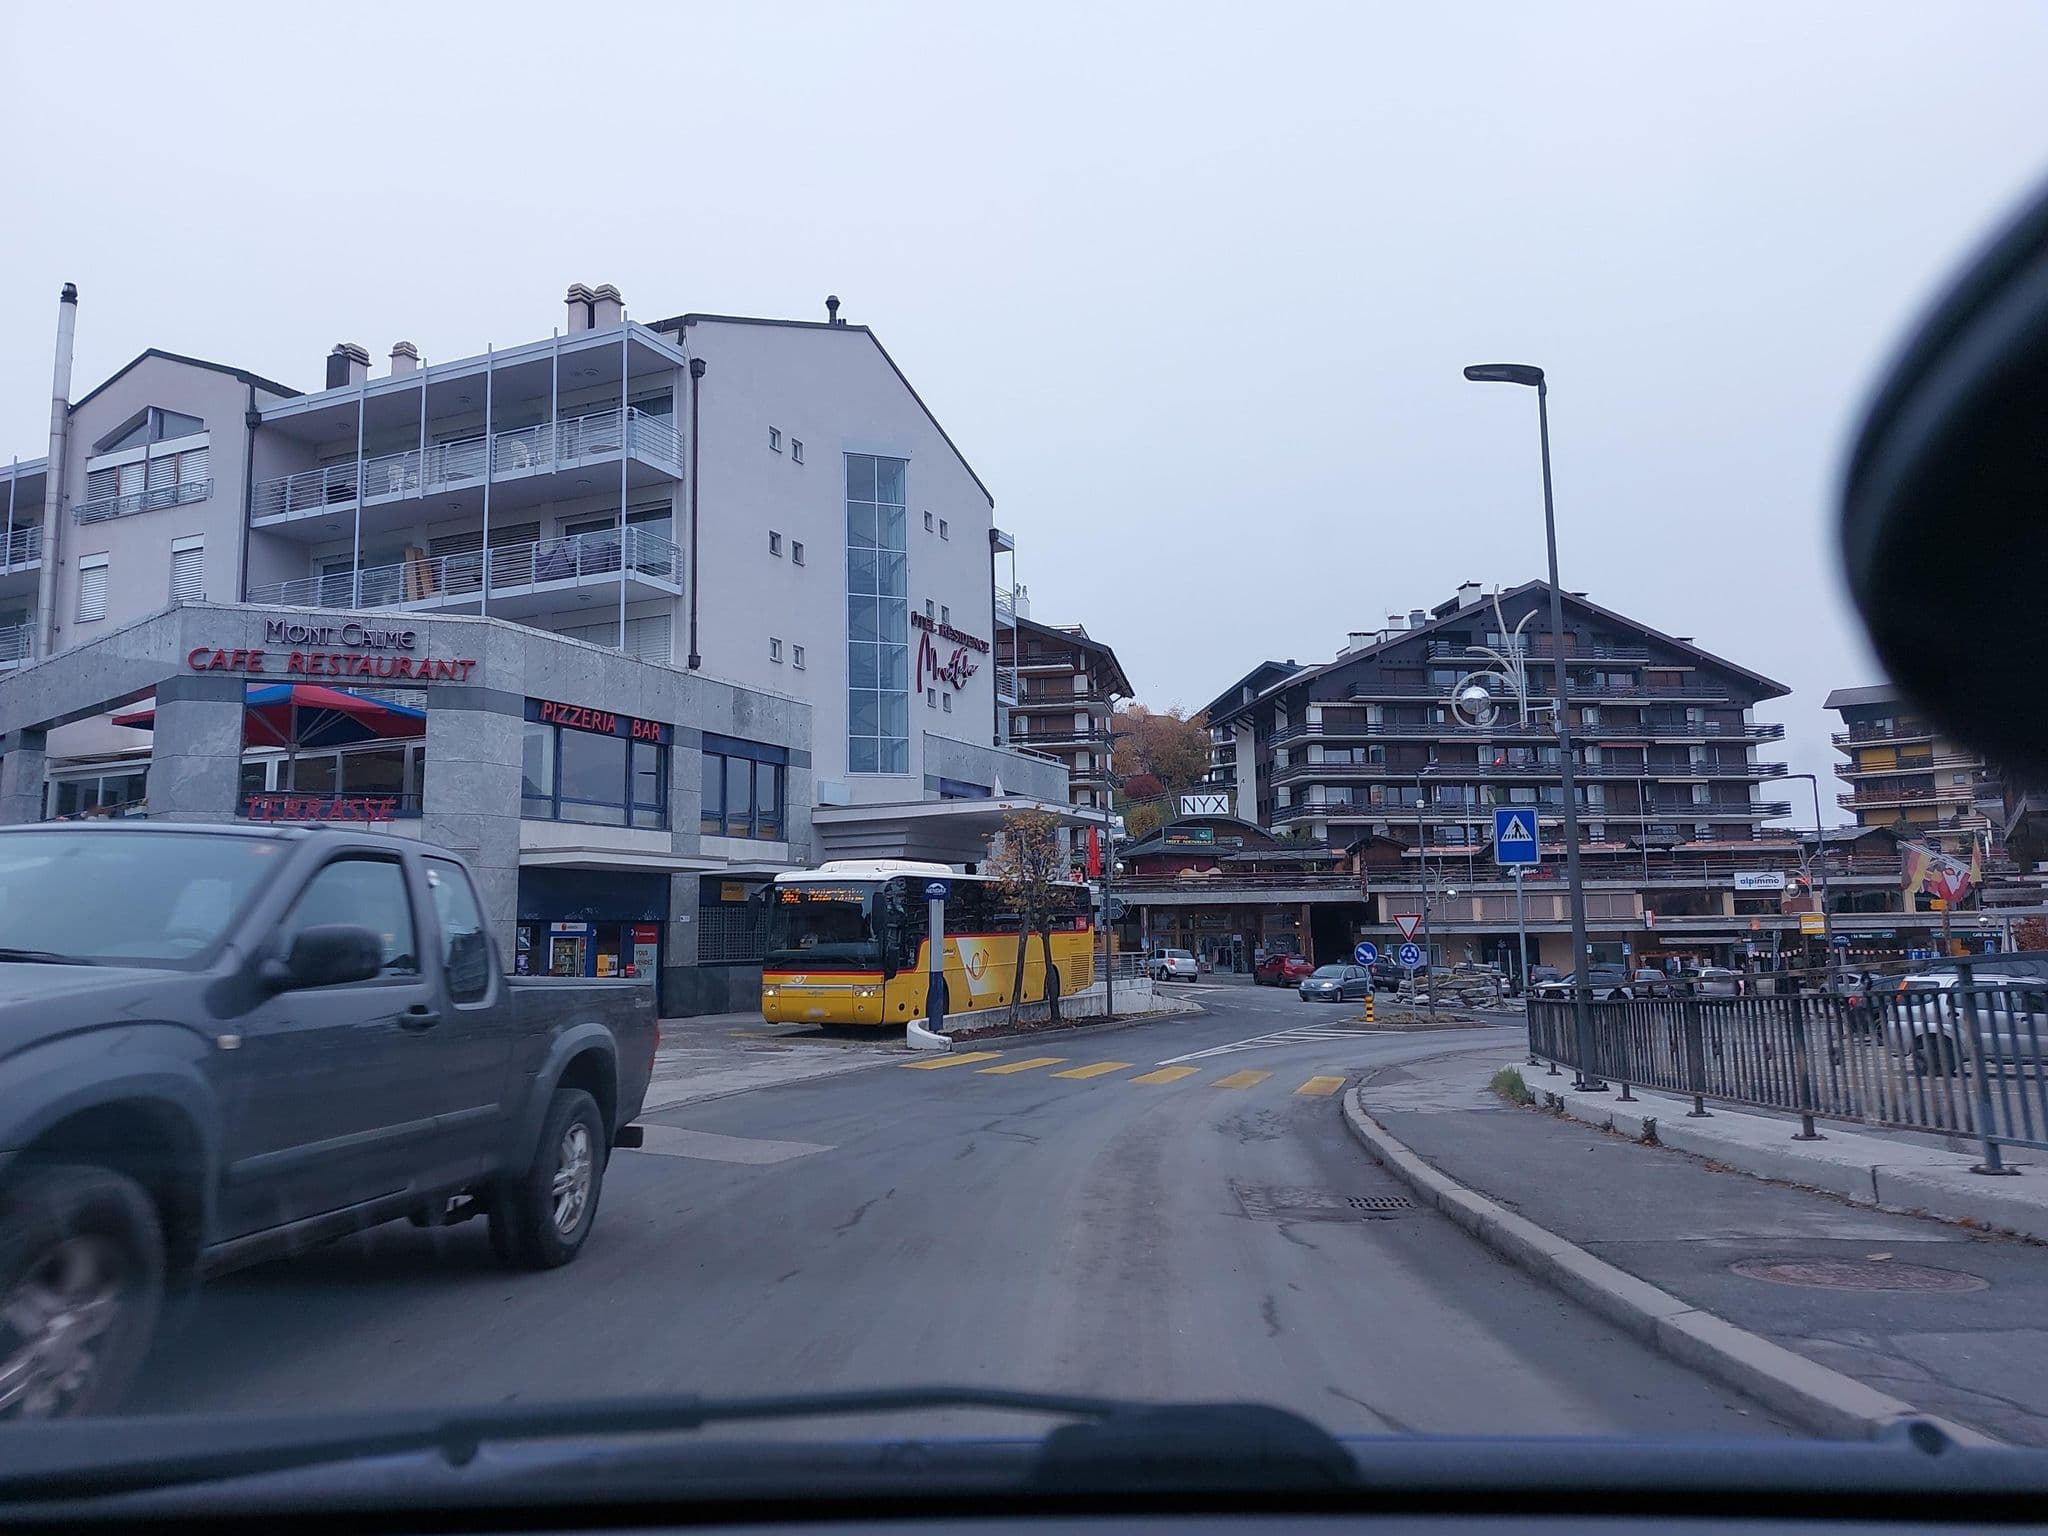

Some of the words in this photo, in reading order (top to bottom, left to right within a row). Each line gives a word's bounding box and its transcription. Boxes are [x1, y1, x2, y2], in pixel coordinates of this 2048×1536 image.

[187, 647, 264, 672] CAFE
[287, 652, 476, 681] RESTAURANT
[542, 702, 616, 733] PIZZERIA
[632, 720, 660, 740] BAR
[246, 796, 396, 822] TERRASSE
[1182, 796, 1226, 813] NYX
[1740, 876, 1780, 888] alpimmo
